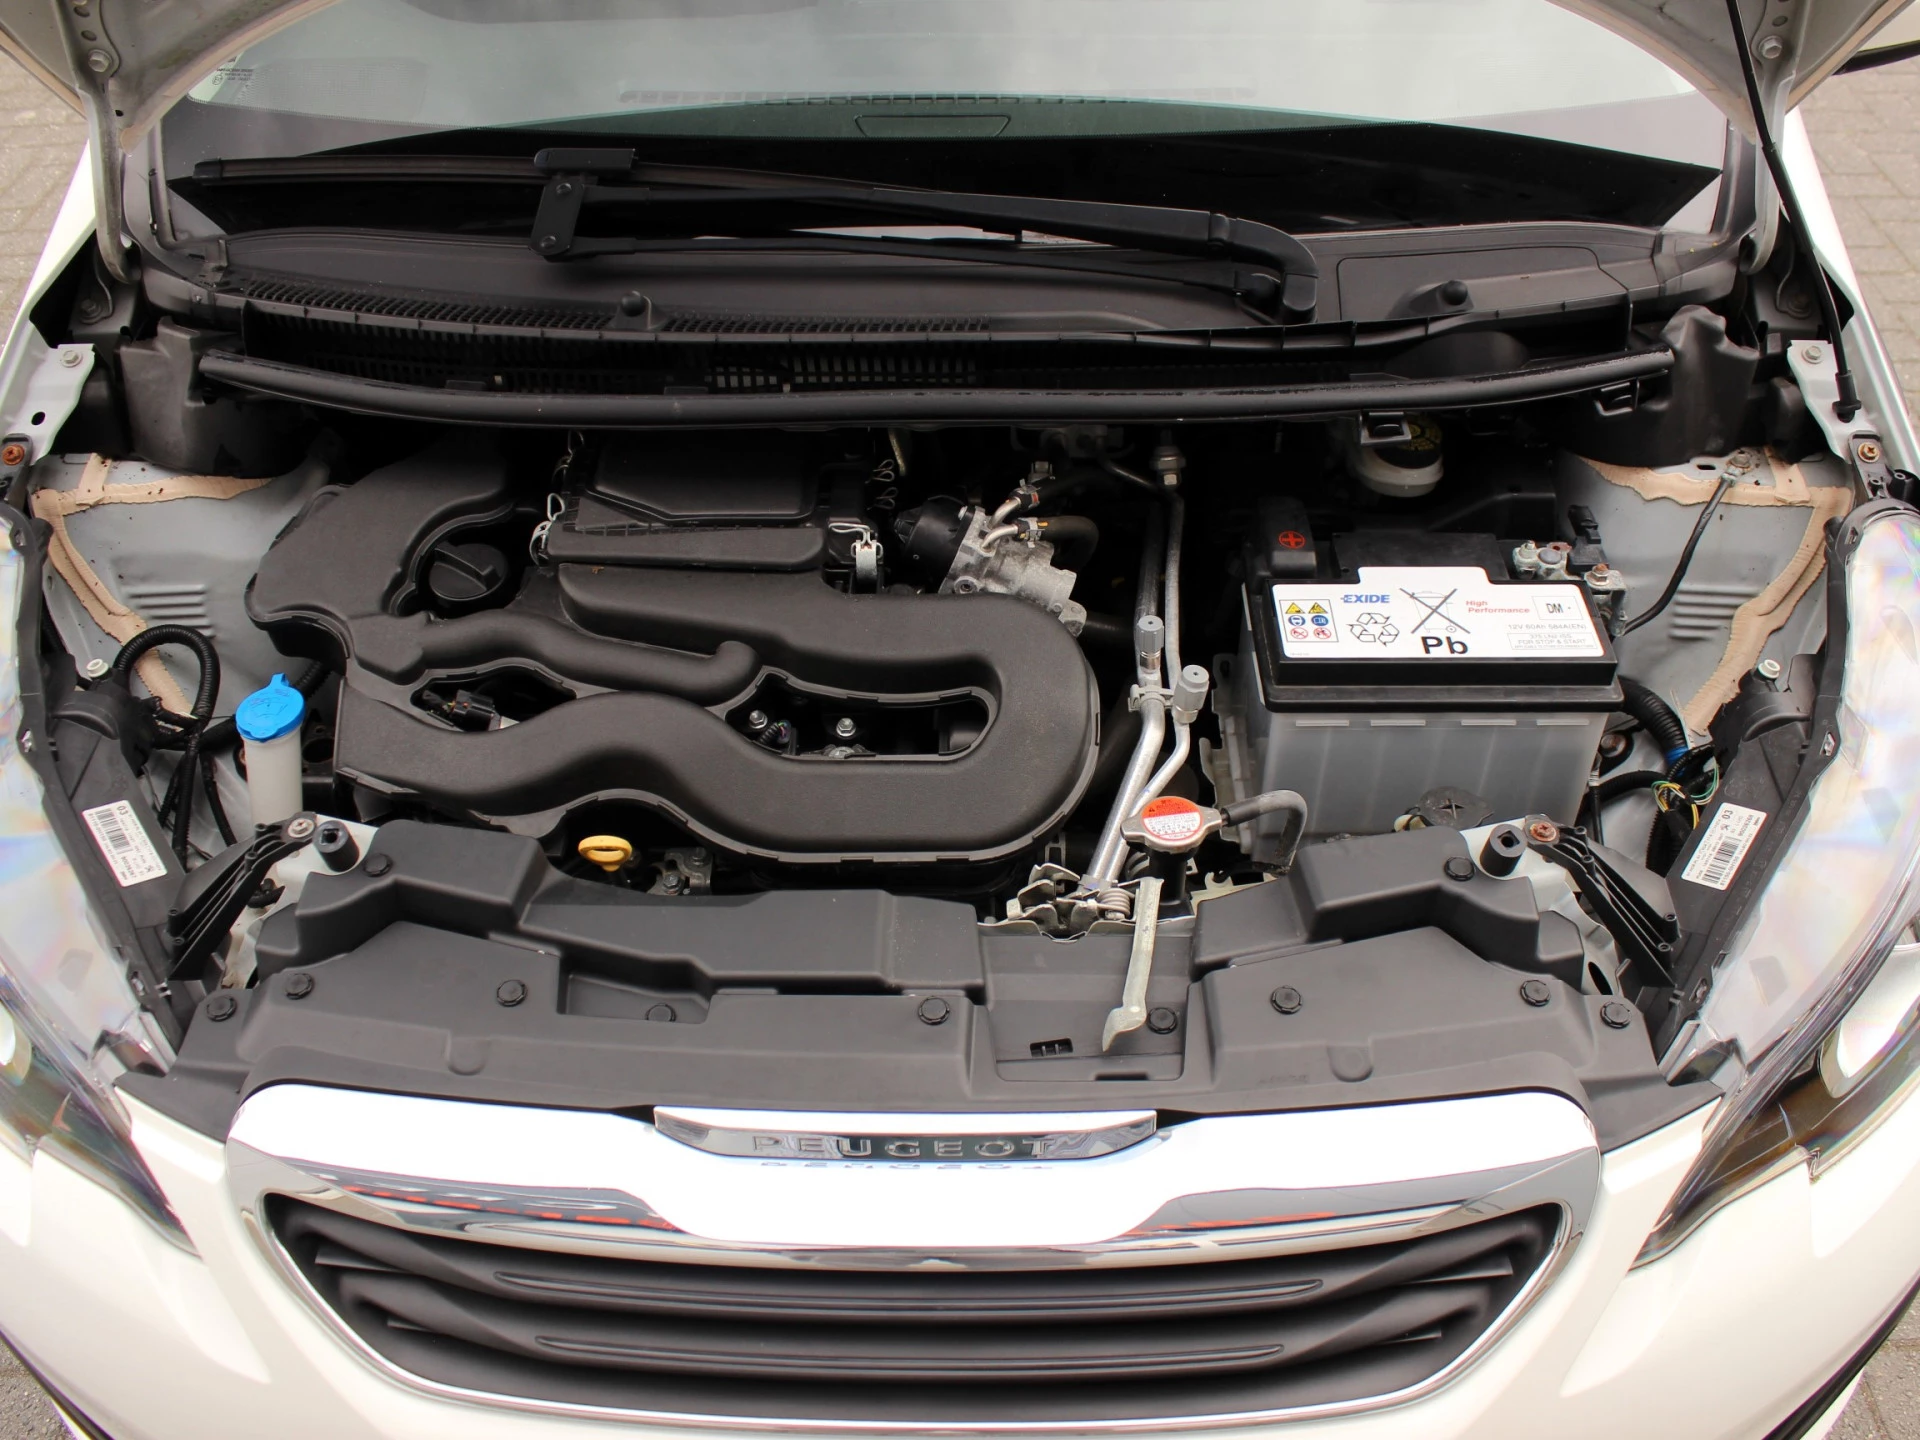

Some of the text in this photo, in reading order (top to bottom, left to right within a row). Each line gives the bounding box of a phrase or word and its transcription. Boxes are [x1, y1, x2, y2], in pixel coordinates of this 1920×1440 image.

[1342, 594, 1391, 604] EXIDE
[1466, 600, 1488, 608] High
[1546, 603, 1564, 614] DM
[1421, 635, 1469, 655] Pb
[1721, 810, 1733, 819] 03
[753, 1135, 1055, 1158] PEUGEOT
